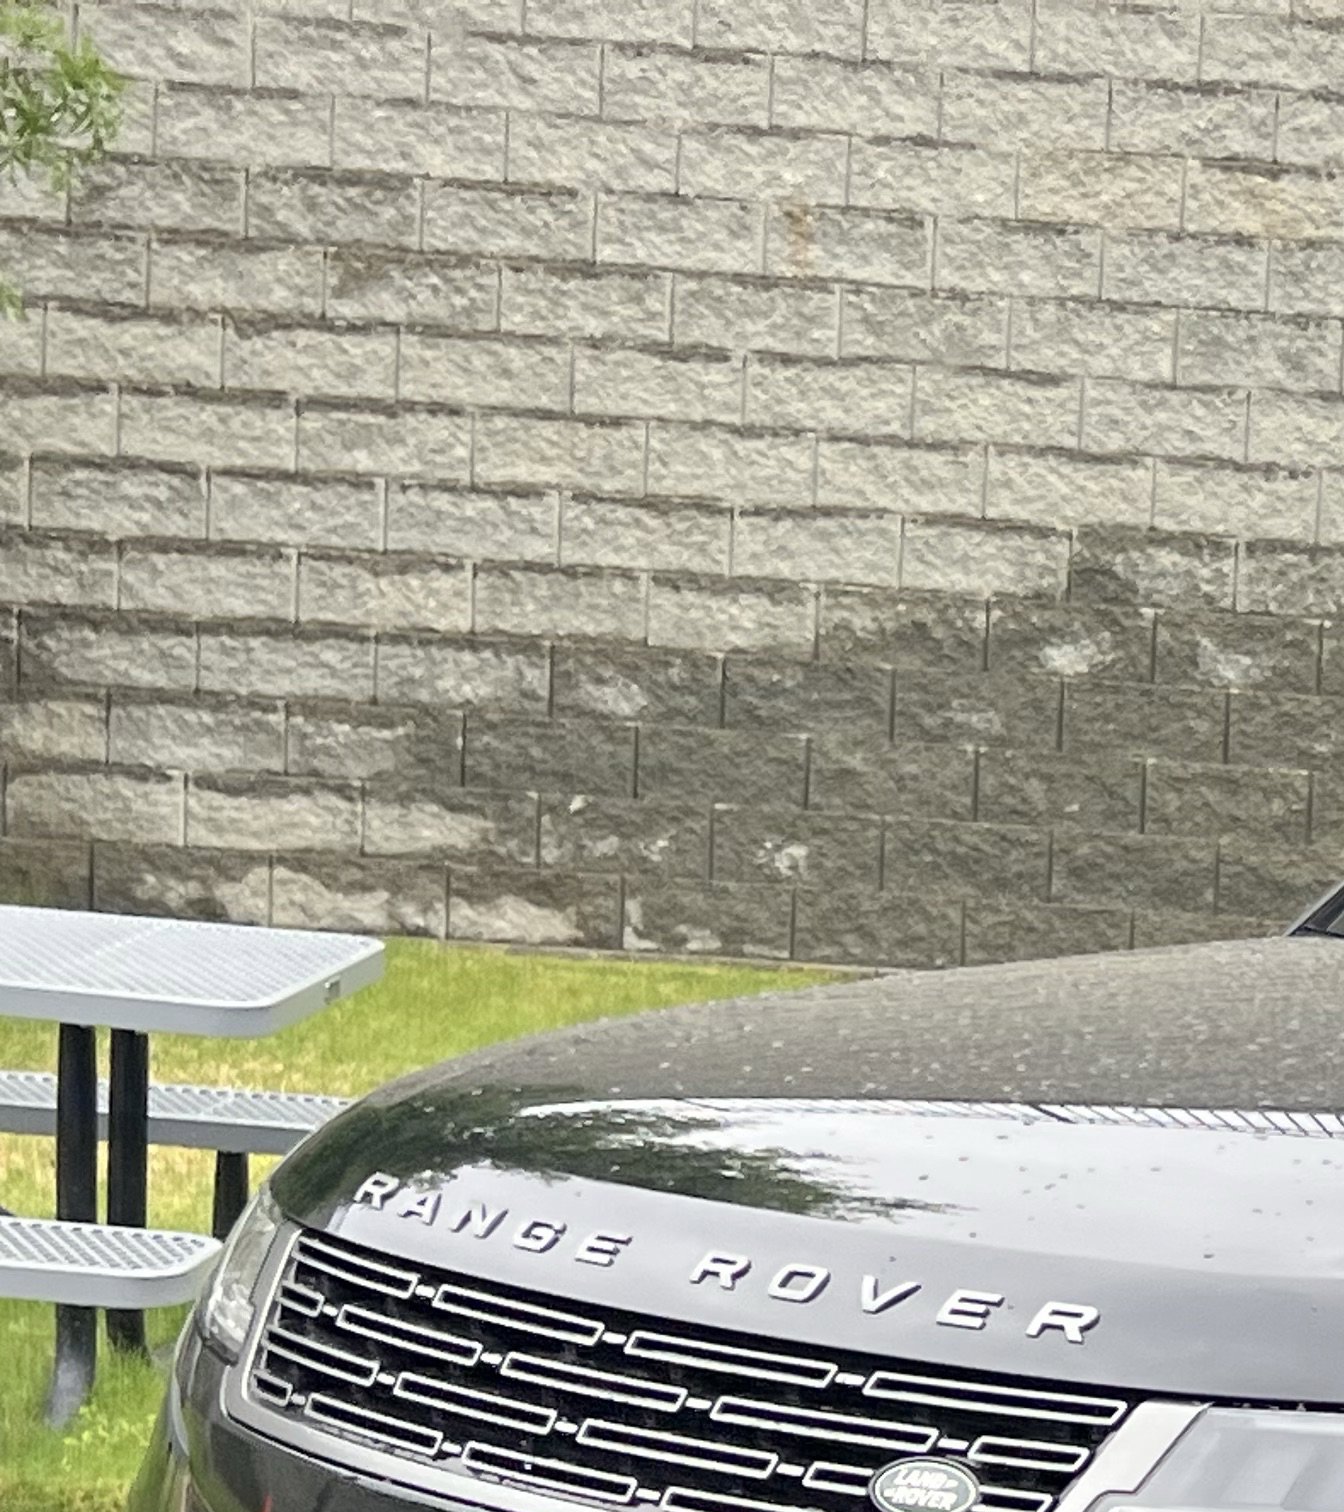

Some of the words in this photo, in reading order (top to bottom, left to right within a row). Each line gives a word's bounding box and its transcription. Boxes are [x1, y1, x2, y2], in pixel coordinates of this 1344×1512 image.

[353, 1171, 633, 1267] RANGE
[689, 1249, 1101, 1344] ROVER
[894, 1468, 953, 1490] LAND
[889, 1486, 958, 1511] ROVER
